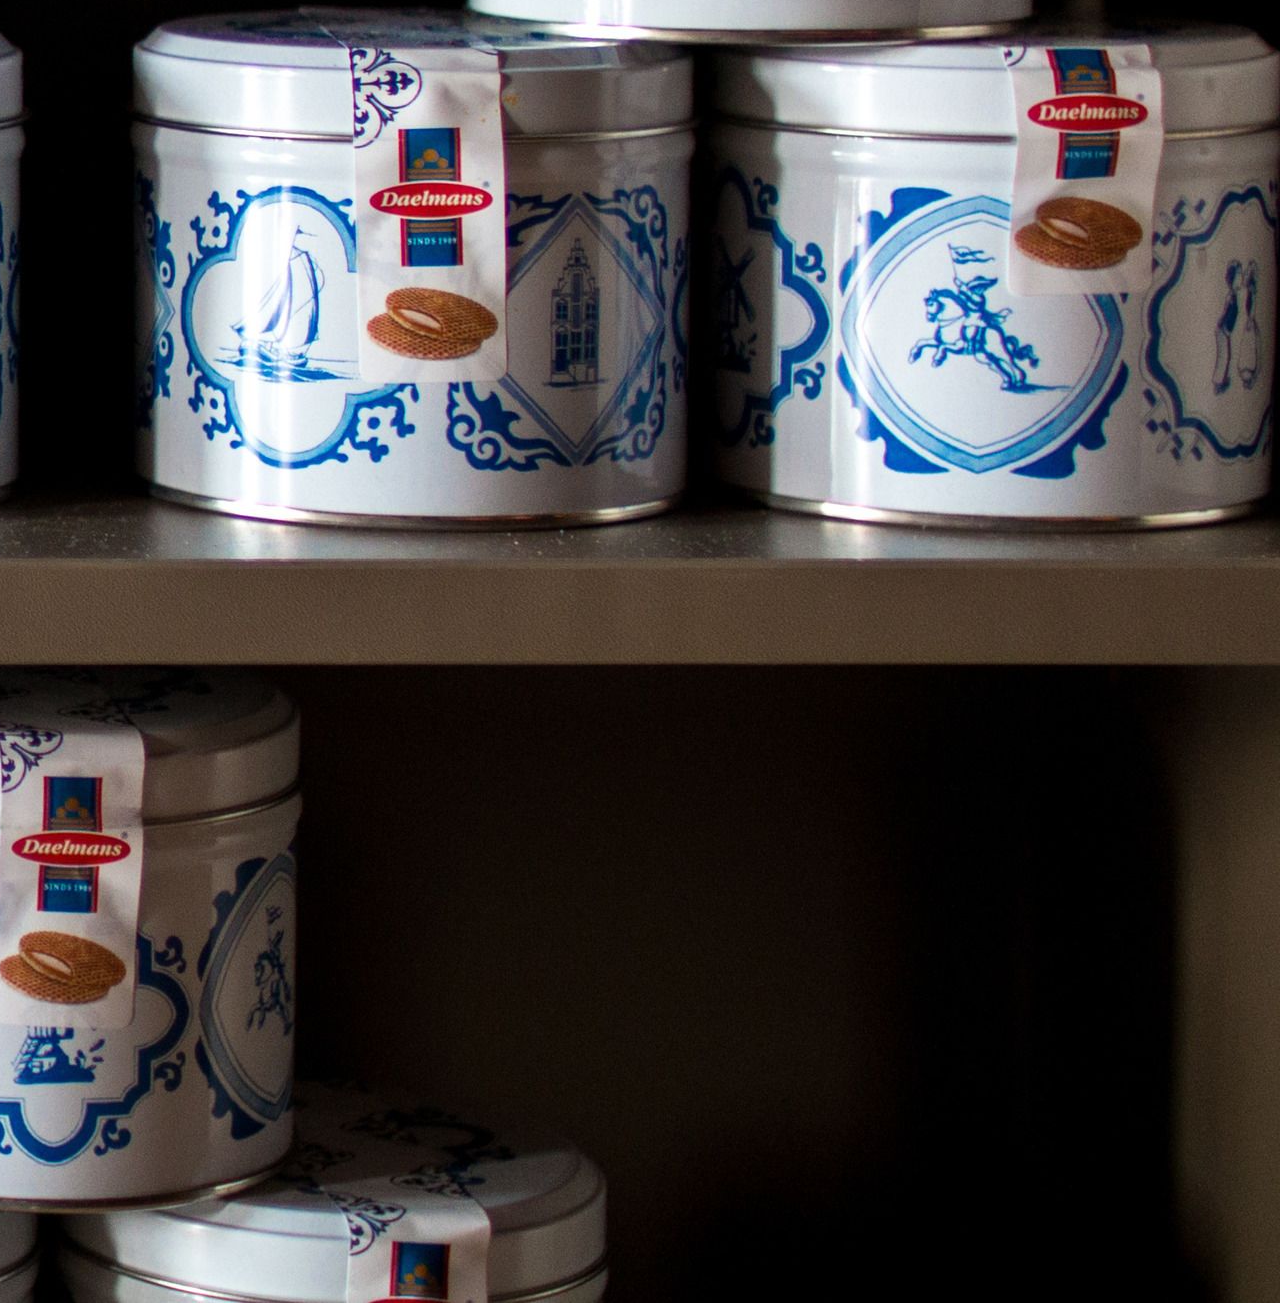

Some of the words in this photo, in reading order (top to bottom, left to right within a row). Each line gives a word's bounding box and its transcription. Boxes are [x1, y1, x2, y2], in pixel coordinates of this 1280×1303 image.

[1039, 104, 1138, 120] Daelmans
[381, 191, 484, 206] Daelmans
[407, 236, 435, 246] SINDS
[22, 840, 121, 856] Daelmans
